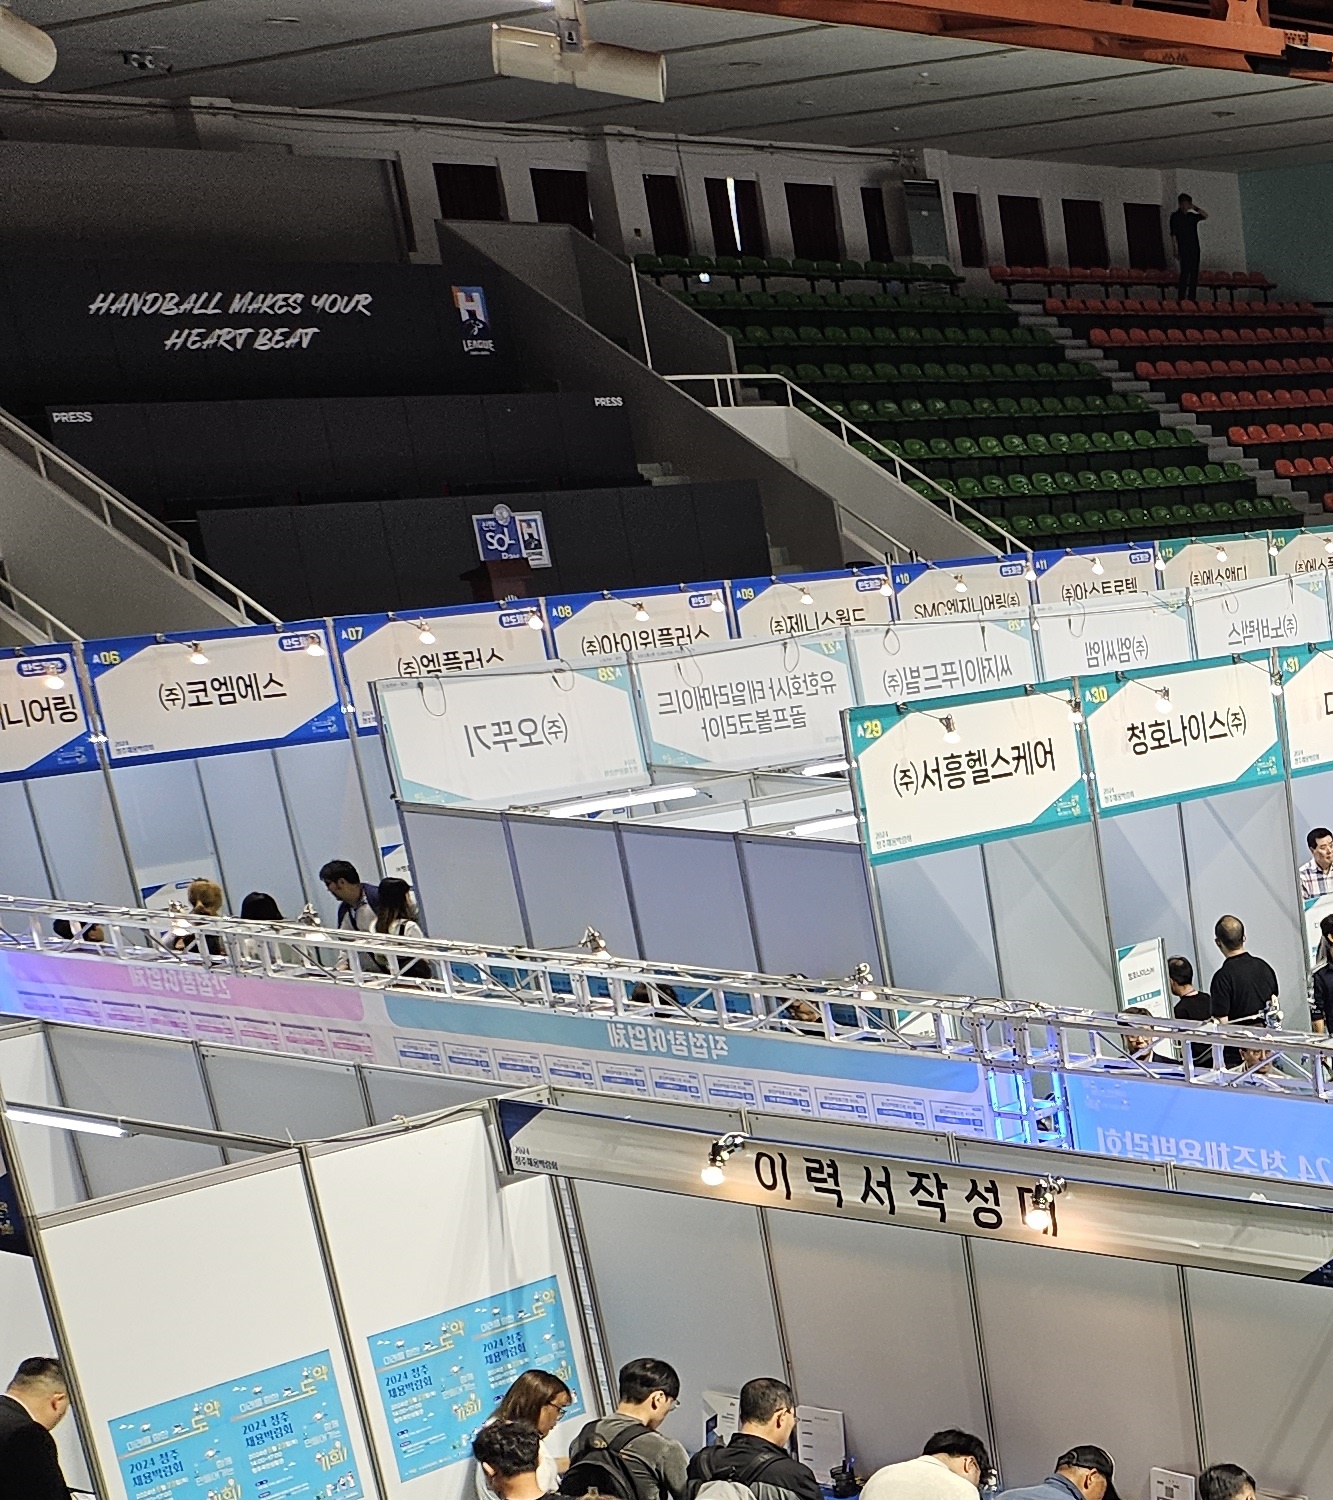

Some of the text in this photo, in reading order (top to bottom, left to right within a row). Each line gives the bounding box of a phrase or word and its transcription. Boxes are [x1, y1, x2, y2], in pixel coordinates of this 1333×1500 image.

[89, 291, 373, 317] HANDBALL MAKES YOUR
[164, 327, 320, 352] HEART BEAT
[462, 339, 495, 352] LEAGUE
[594, 397, 623, 407] PRESS
[53, 411, 93, 424] PRESS
[485, 528, 516, 551] SOL
[736, 587, 755, 601] A09
[552, 604, 573, 619] A08
[341, 626, 363, 642] A07
[92, 650, 122, 666] A06
[158, 672, 288, 711] (주)코엠에스
[1085, 687, 1108, 703] A30
[857, 720, 882, 740] A29
[1126, 706, 1247, 756] 청호나이스(주)
[893, 738, 1055, 797] (주)서흥헬스케어
[482, 1338, 505, 1353] 2024
[385, 1372, 409, 1386] 2024
[387, 1375, 433, 1399] 채용박람회
[242, 1411, 289, 1435] 2024 청주
[245, 1423, 294, 1449] 채용박람회
[129, 1448, 180, 1474] 2024 청주
[132, 1462, 184, 1487] 채용박람회
